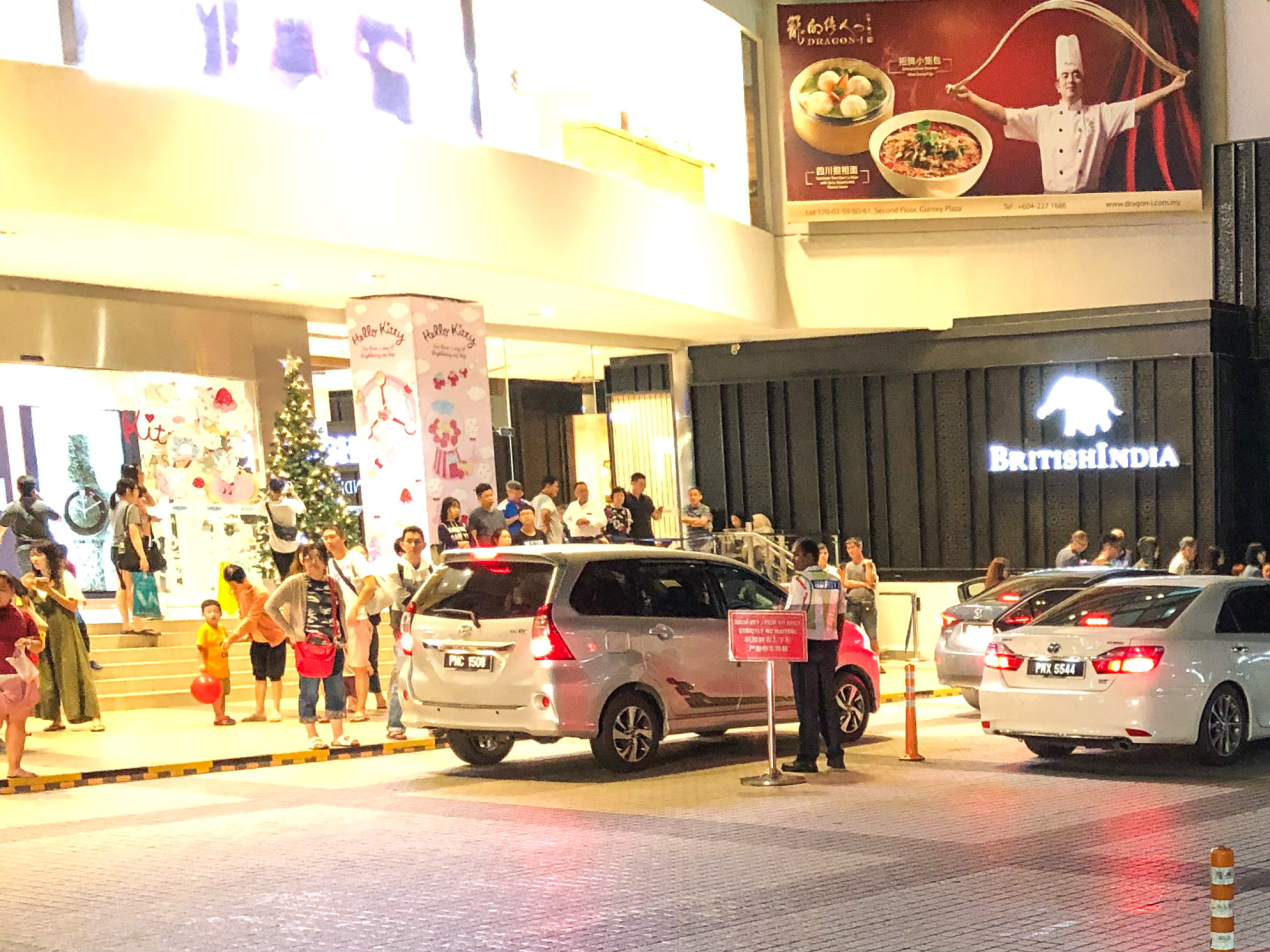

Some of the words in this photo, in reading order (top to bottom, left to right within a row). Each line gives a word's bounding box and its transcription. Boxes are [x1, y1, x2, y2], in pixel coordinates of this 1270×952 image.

[874, 206, 899, 215] Second
[919, 205, 944, 215] Gurney
[944, 204, 963, 213] Plaza
[1105, 199, 1181, 208] www.dragon-i.com.my
[352, 325, 378, 345] Hello
[379, 321, 405, 346] Kitty
[422, 323, 450, 342] Hello
[451, 322, 477, 349] Kitty
[1053, 663, 1075, 675] 5544
